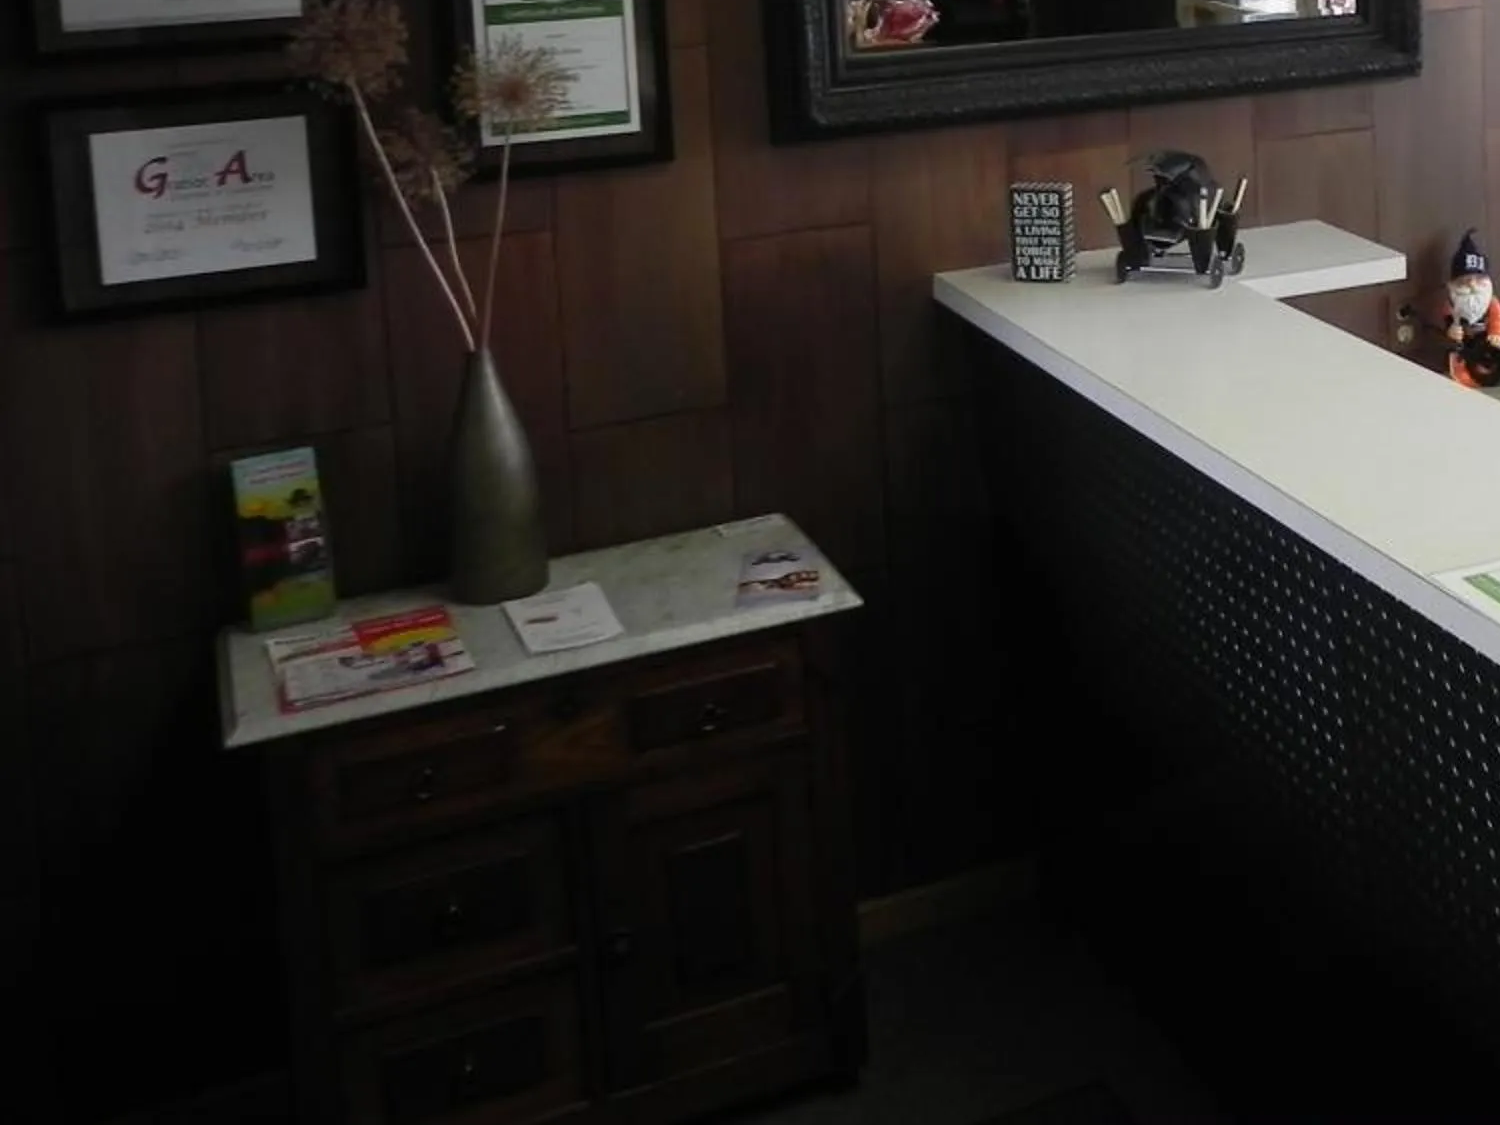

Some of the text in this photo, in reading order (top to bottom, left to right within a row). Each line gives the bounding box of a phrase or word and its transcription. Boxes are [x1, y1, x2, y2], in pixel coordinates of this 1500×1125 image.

[1014, 193, 1059, 205] NEVER
[1014, 206, 1060, 218] GET SO
[1025, 227, 1061, 235] LIVING
[1016, 246, 1061, 256] FORGET
[1016, 256, 1031, 267] TO
[1016, 266, 1062, 280] A LIFE
